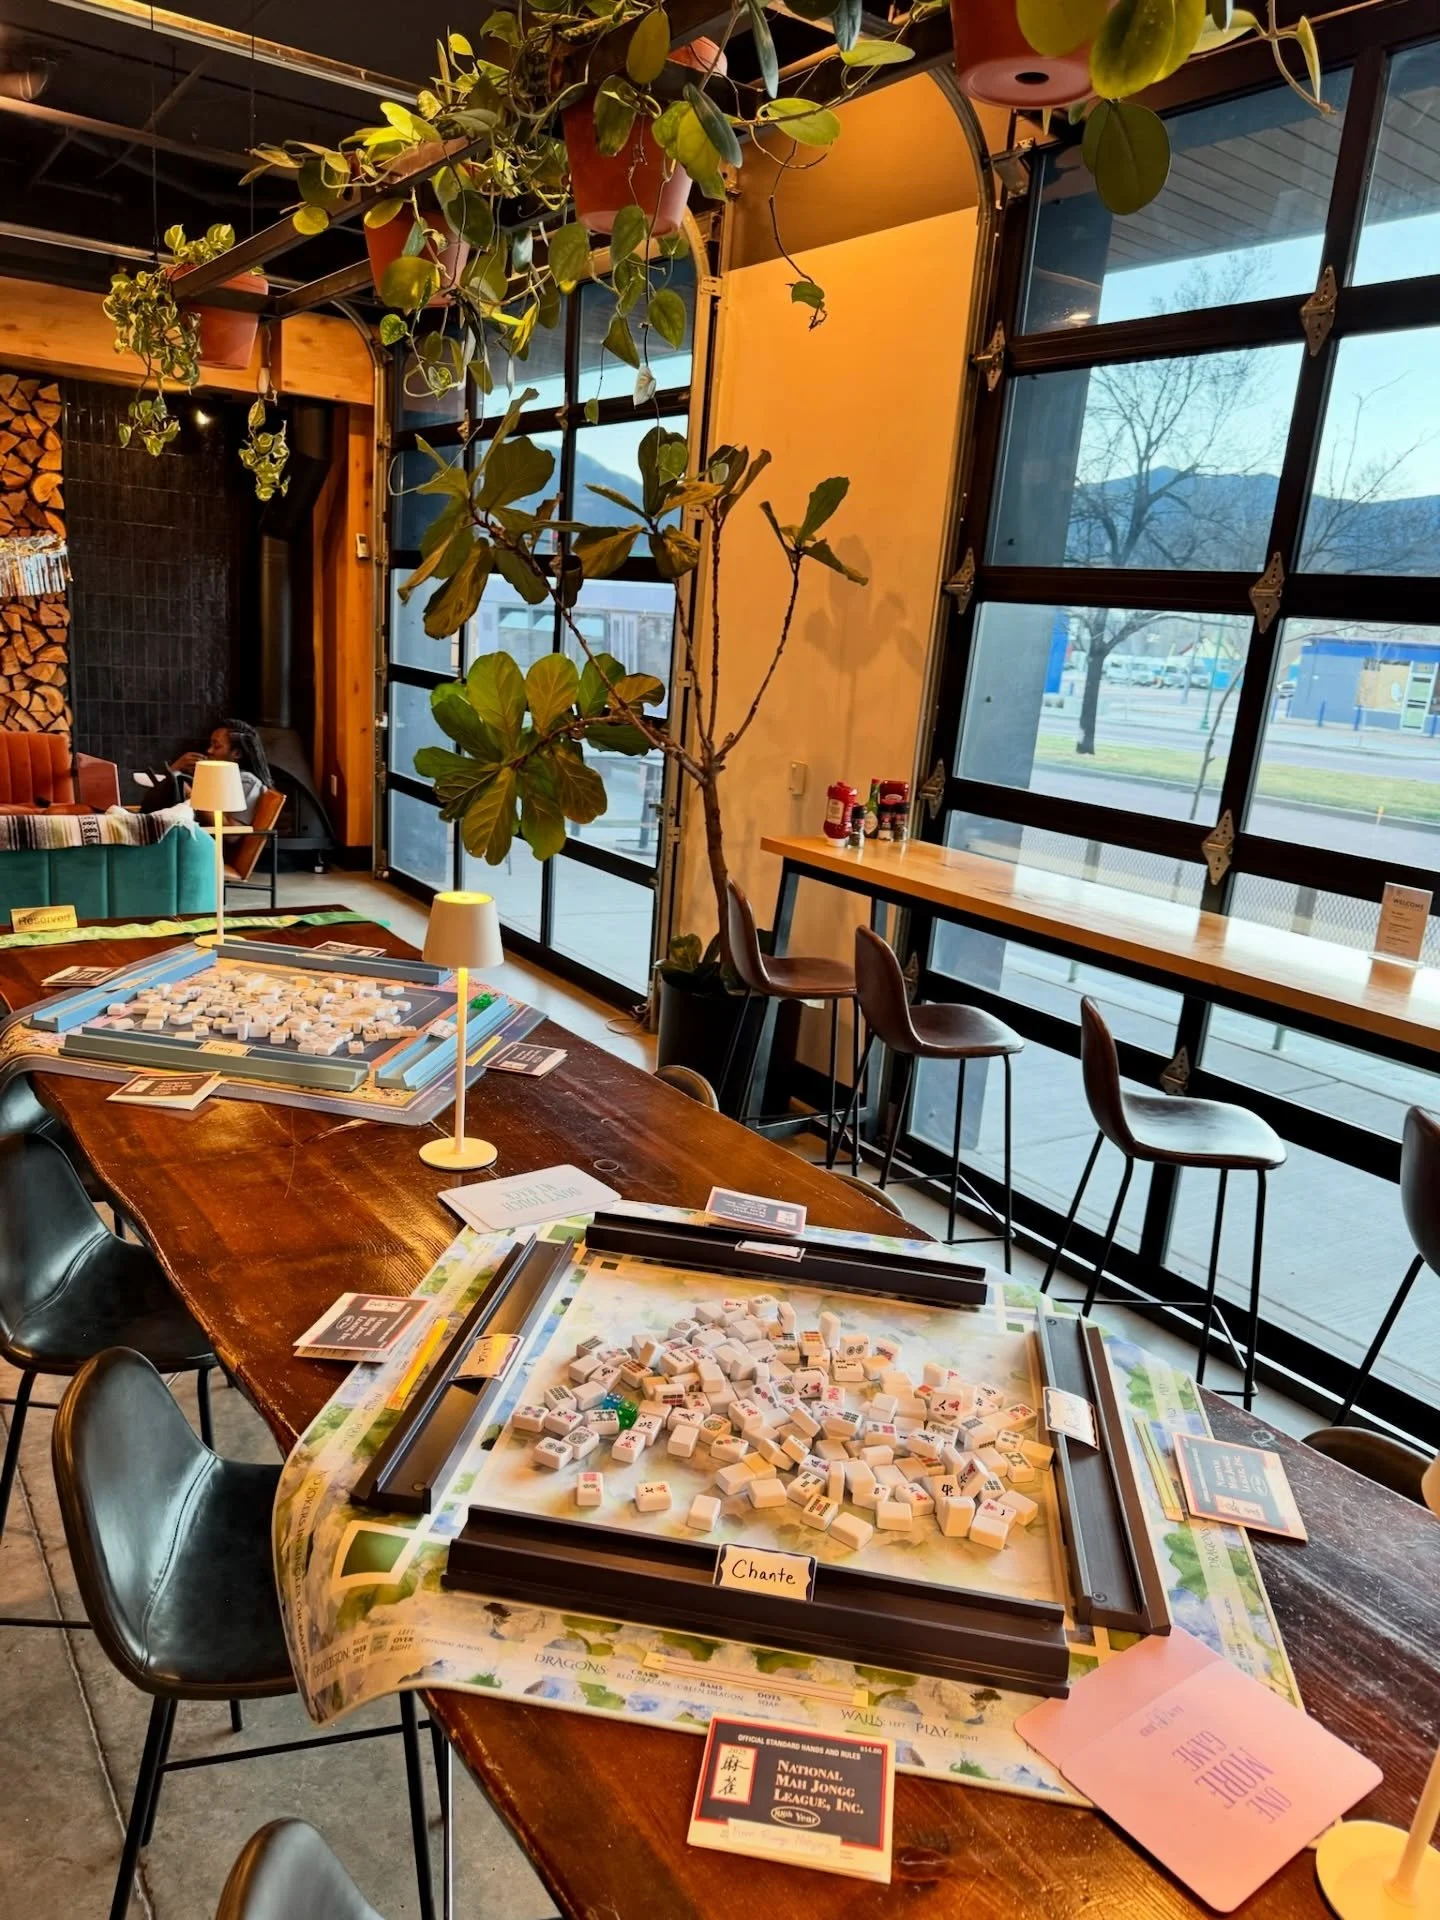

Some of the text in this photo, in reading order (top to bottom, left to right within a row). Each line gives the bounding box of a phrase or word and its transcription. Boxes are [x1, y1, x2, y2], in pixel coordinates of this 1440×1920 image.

[18, 914, 71, 926] Reserved
[731, 1559, 796, 1585] Chante
[705, 1687, 744, 1702] DRAGON
[757, 1692, 782, 1702] DOTS
[737, 1734, 862, 1761] OFFICIAL STANDARD HANDS AND RULES
[1172, 1730, 1227, 1772] GAME
[777, 1759, 843, 1782] NATIONAL
[1194, 1746, 1274, 1810] MORE
[775, 1774, 856, 1799] MAH JONGG
[773, 1788, 864, 1815] LEAGUE, INC.
[1246, 1785, 1293, 1824] ONE
[794, 1811, 818, 1824] Year
